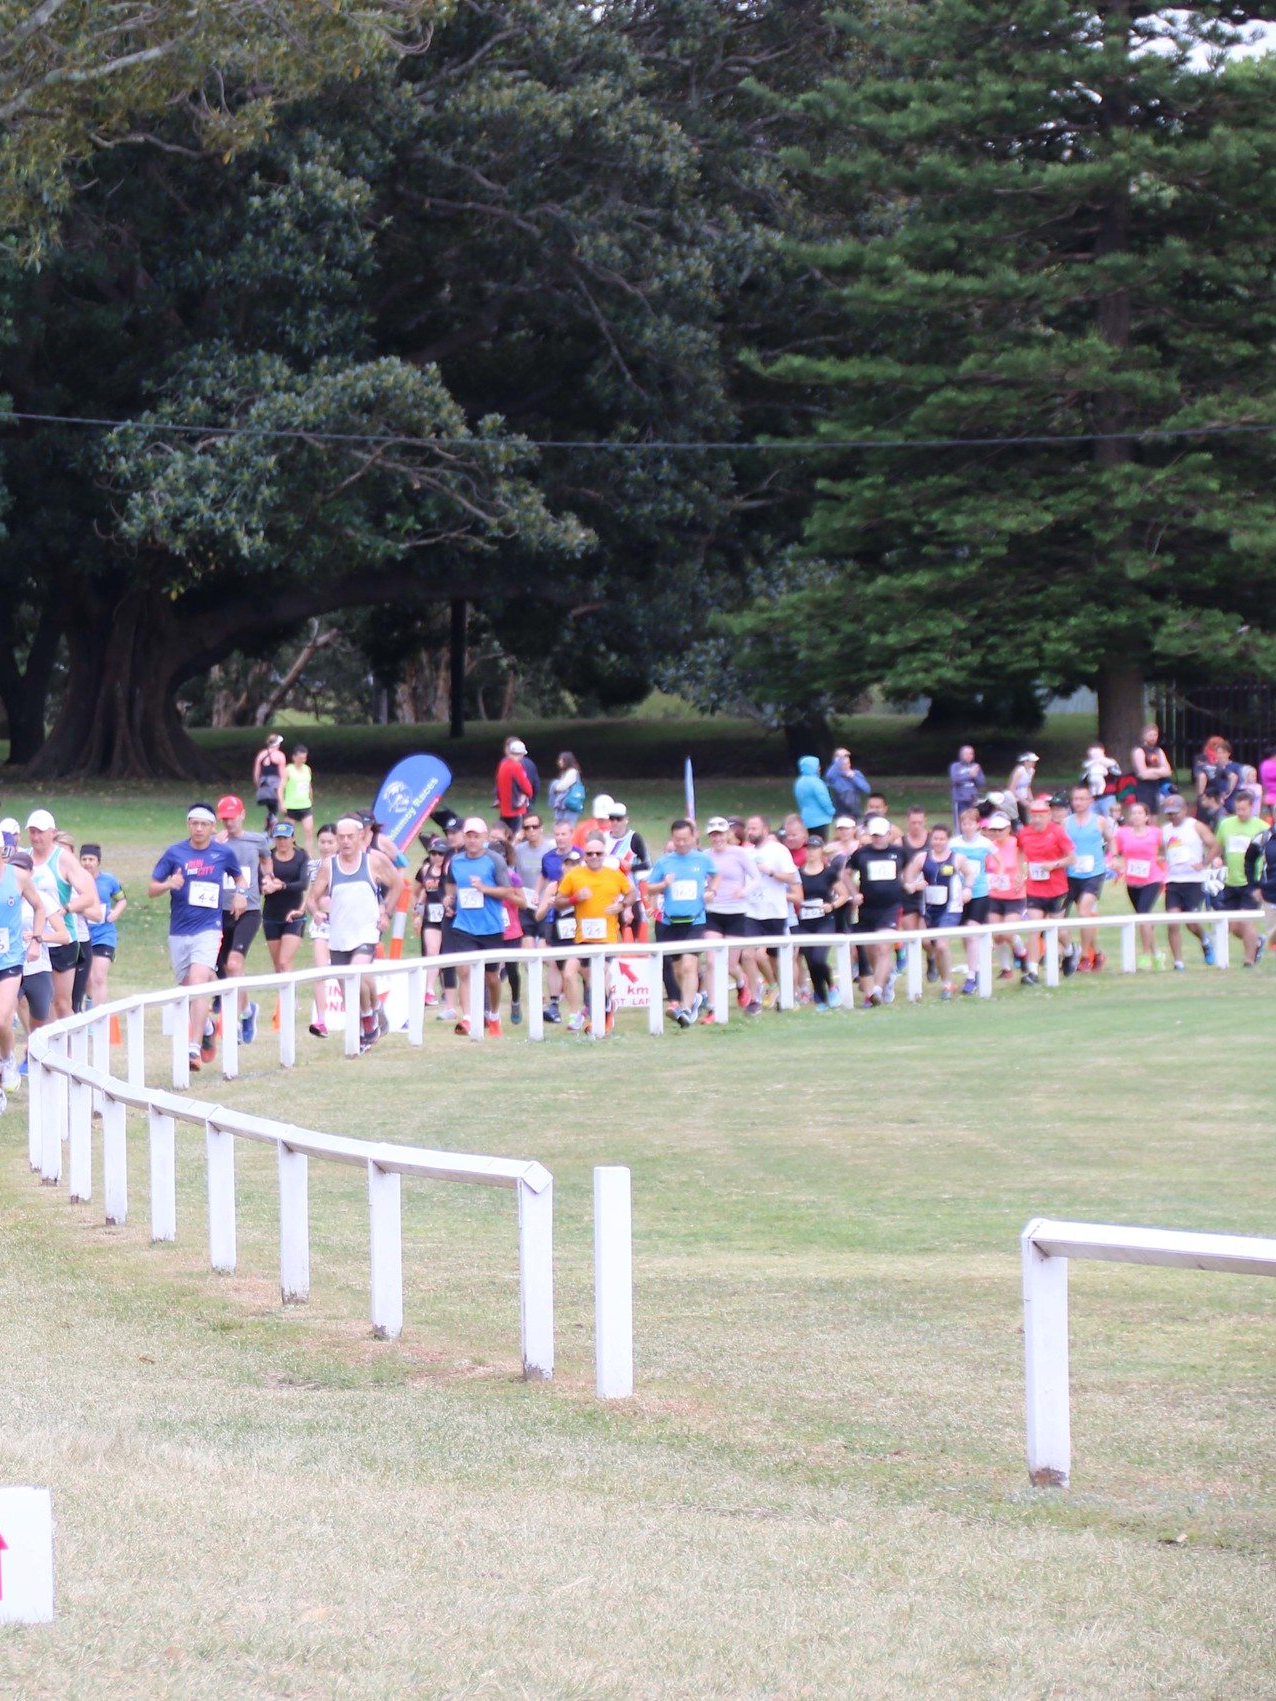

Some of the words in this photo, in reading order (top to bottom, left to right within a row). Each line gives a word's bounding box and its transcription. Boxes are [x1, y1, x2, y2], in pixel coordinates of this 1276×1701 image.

[411, 777, 439, 808] Races
[197, 865, 215, 877] CITY
[627, 985, 649, 995] km
